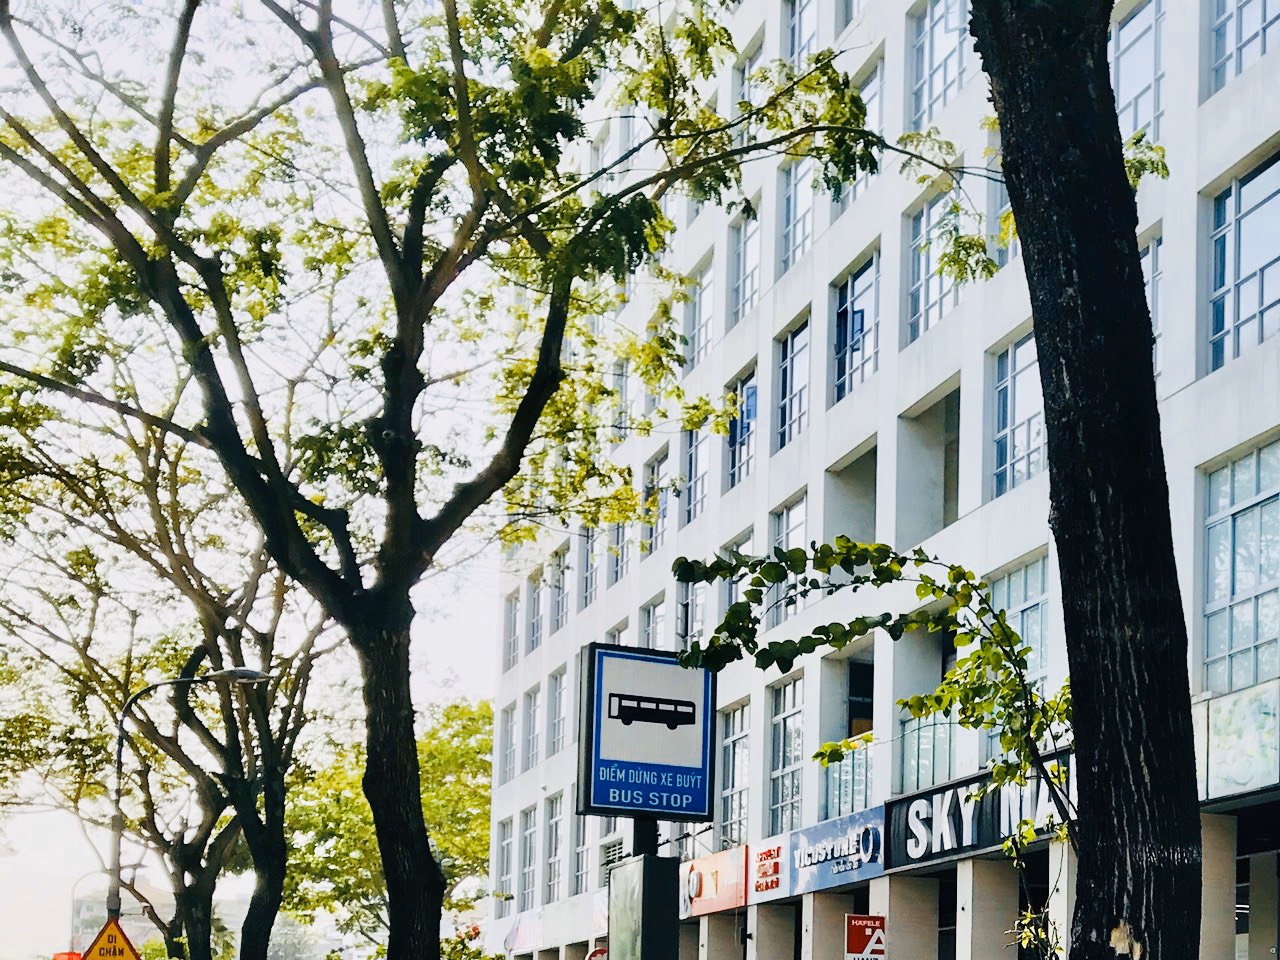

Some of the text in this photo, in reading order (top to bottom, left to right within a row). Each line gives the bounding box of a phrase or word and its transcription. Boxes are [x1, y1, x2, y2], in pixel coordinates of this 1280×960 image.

[599, 763, 626, 783] ĐIỂM
[660, 772, 674, 787] XE
[676, 772, 702, 789] BUÝT
[609, 788, 693, 808] BUS STOP
[906, 782, 981, 860] SKY
